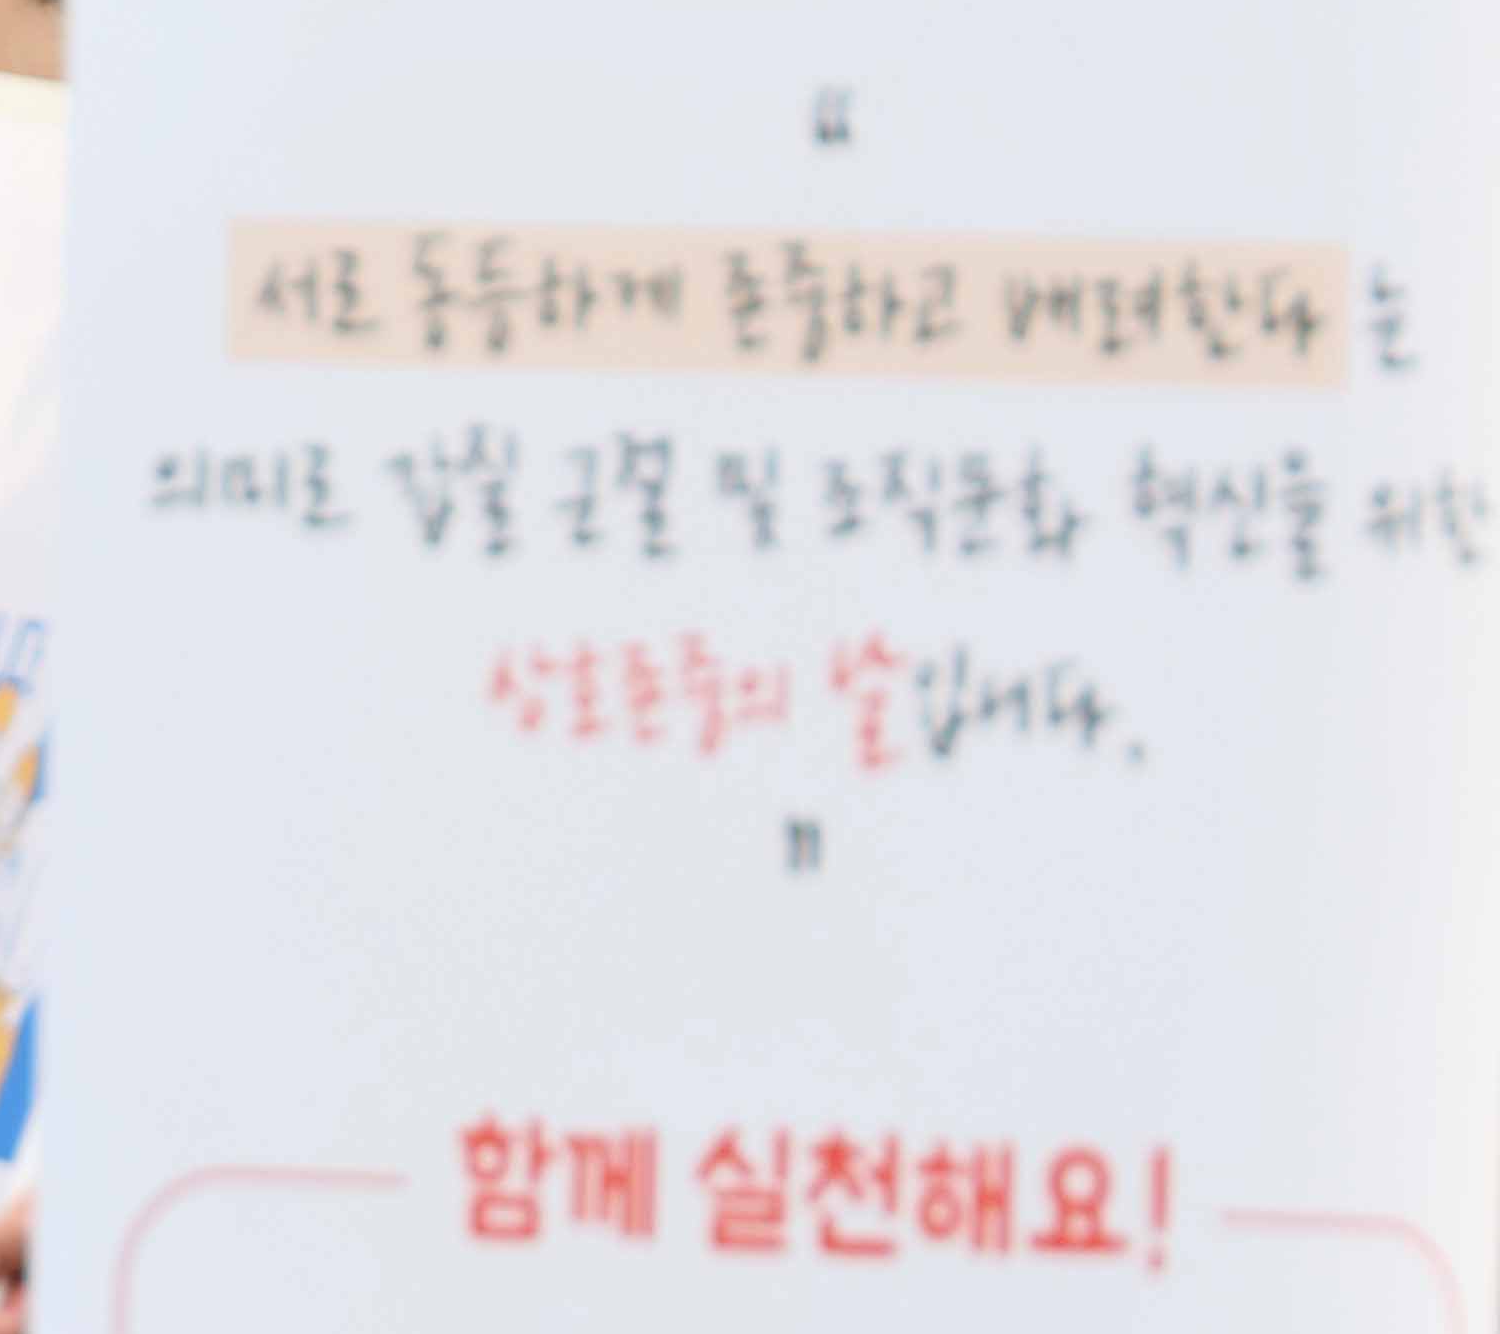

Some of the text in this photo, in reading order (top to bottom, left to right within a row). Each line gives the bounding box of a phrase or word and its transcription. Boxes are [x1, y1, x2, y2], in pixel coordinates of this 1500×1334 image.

[257, 245, 382, 337] 서로
[458, 1115, 1174, 1277] 함께 실천해요!
